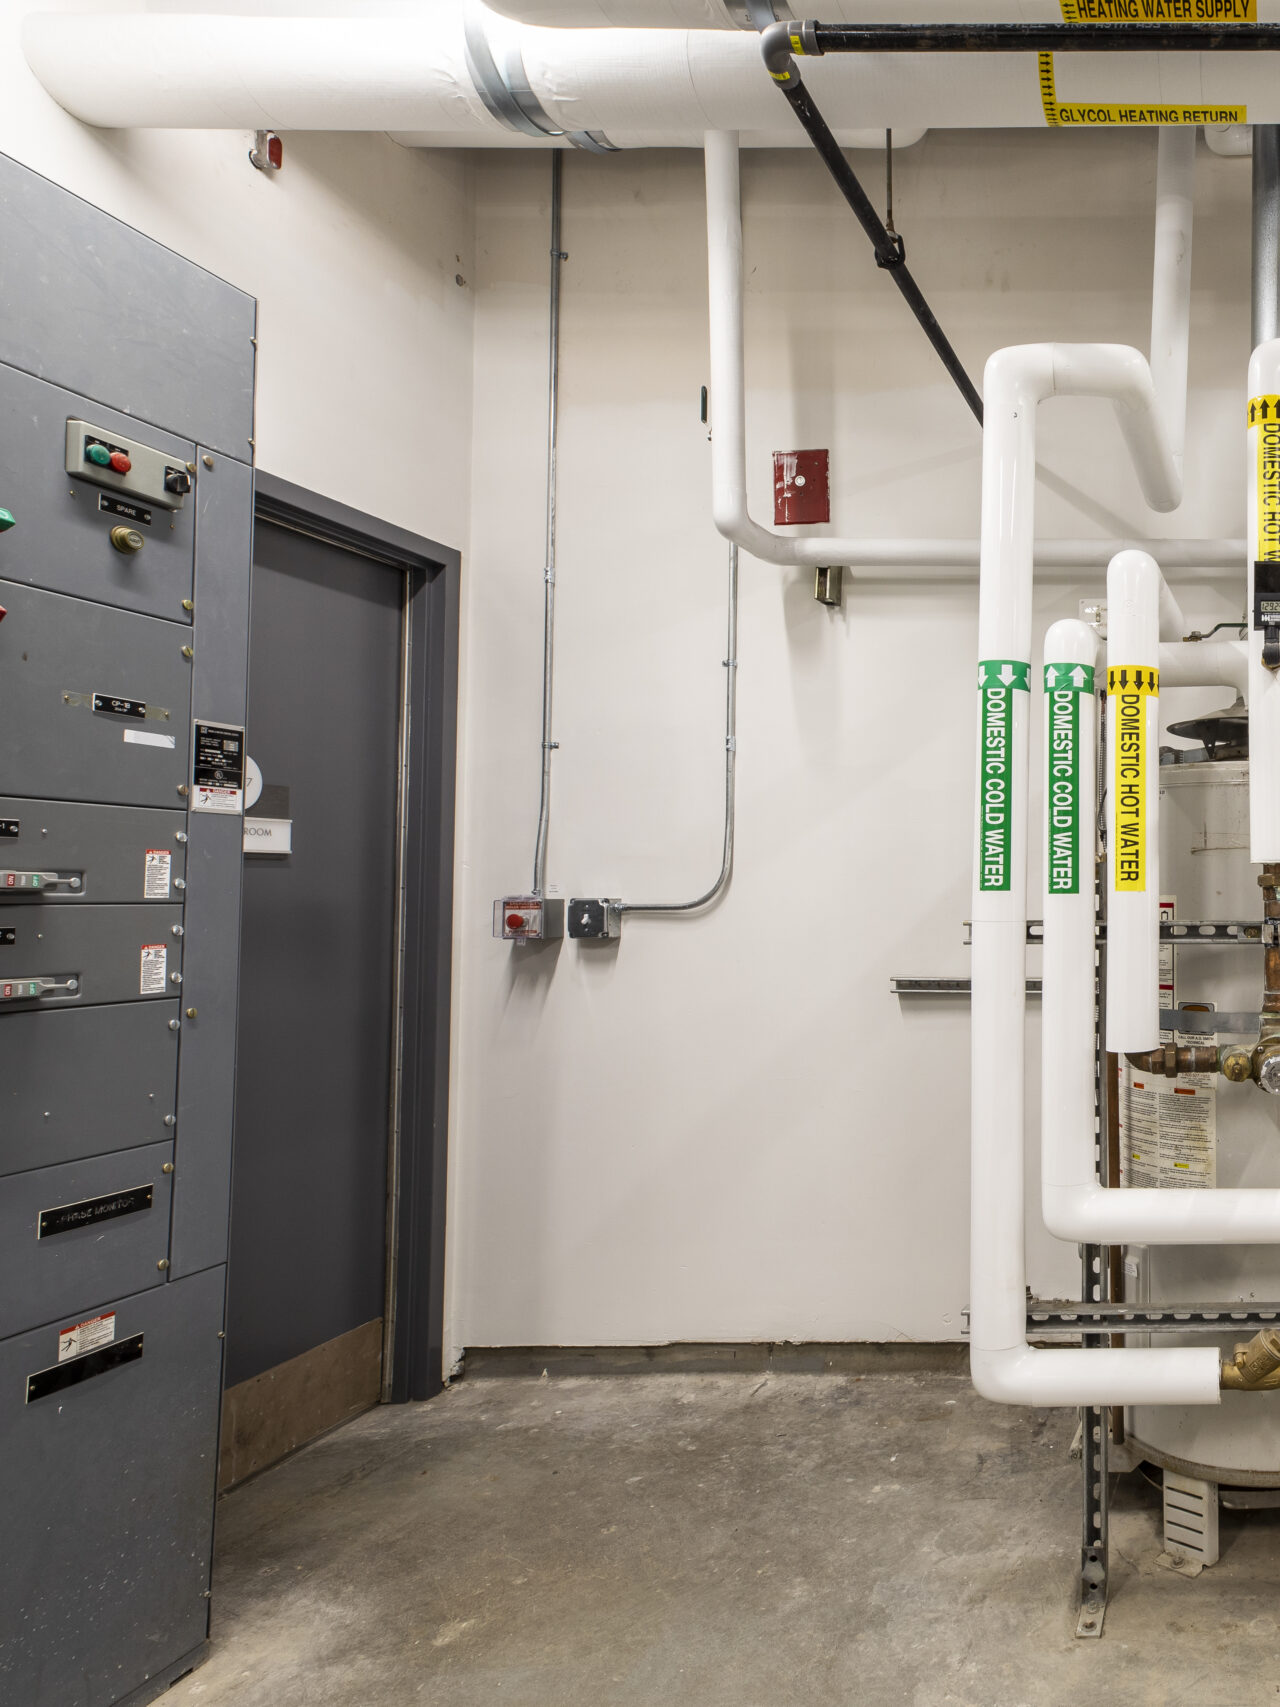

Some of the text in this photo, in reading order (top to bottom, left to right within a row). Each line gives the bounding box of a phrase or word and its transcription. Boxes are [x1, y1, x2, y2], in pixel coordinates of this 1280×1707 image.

[1077, 0, 1250, 18] HEATING WATER SUPPLY
[1059, 108, 1239, 123] GLYCOL HEATING RETURN
[984, 688, 1006, 887] DOMESTIC COLD WATER
[1052, 690, 1073, 890] DOMESTIC COLD WATER
[1120, 694, 1140, 882] DOMESTIC HOT WATER
[244, 827, 272, 837] ROOM
[80, 1316, 101, 1328] DANGER
